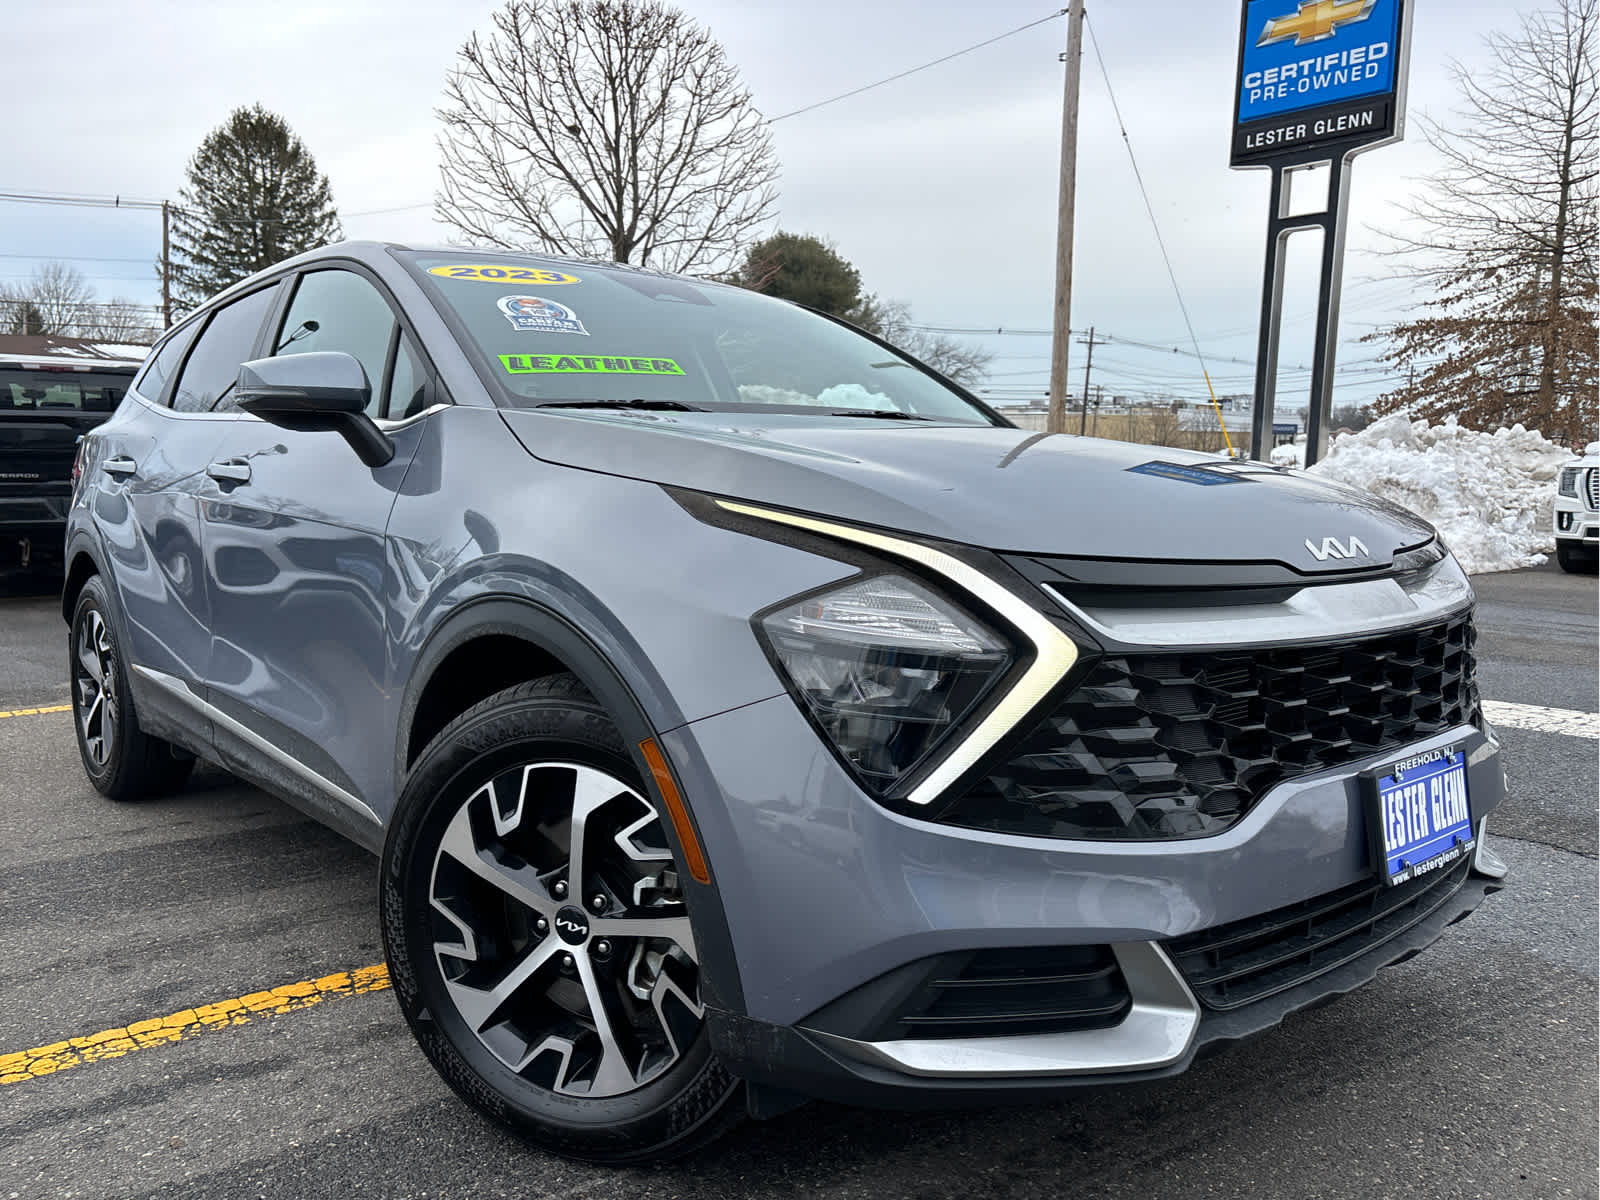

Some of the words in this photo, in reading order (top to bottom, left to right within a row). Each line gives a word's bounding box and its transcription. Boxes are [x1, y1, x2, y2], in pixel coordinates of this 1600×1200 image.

[1244, 42, 1389, 89] CERTIFIED
[1249, 62, 1379, 104] PRE-OWNED
[1246, 124, 1306, 149] LESTER
[1313, 110, 1374, 137] GLENN
[450, 267, 568, 283] 2023
[507, 355, 682, 373] LEATHER
[1303, 535, 1369, 561] KIA
[1394, 750, 1443, 773] FREEHOLD,
[1381, 781, 1430, 852] LESTER
[1430, 767, 1469, 833] GLENN
